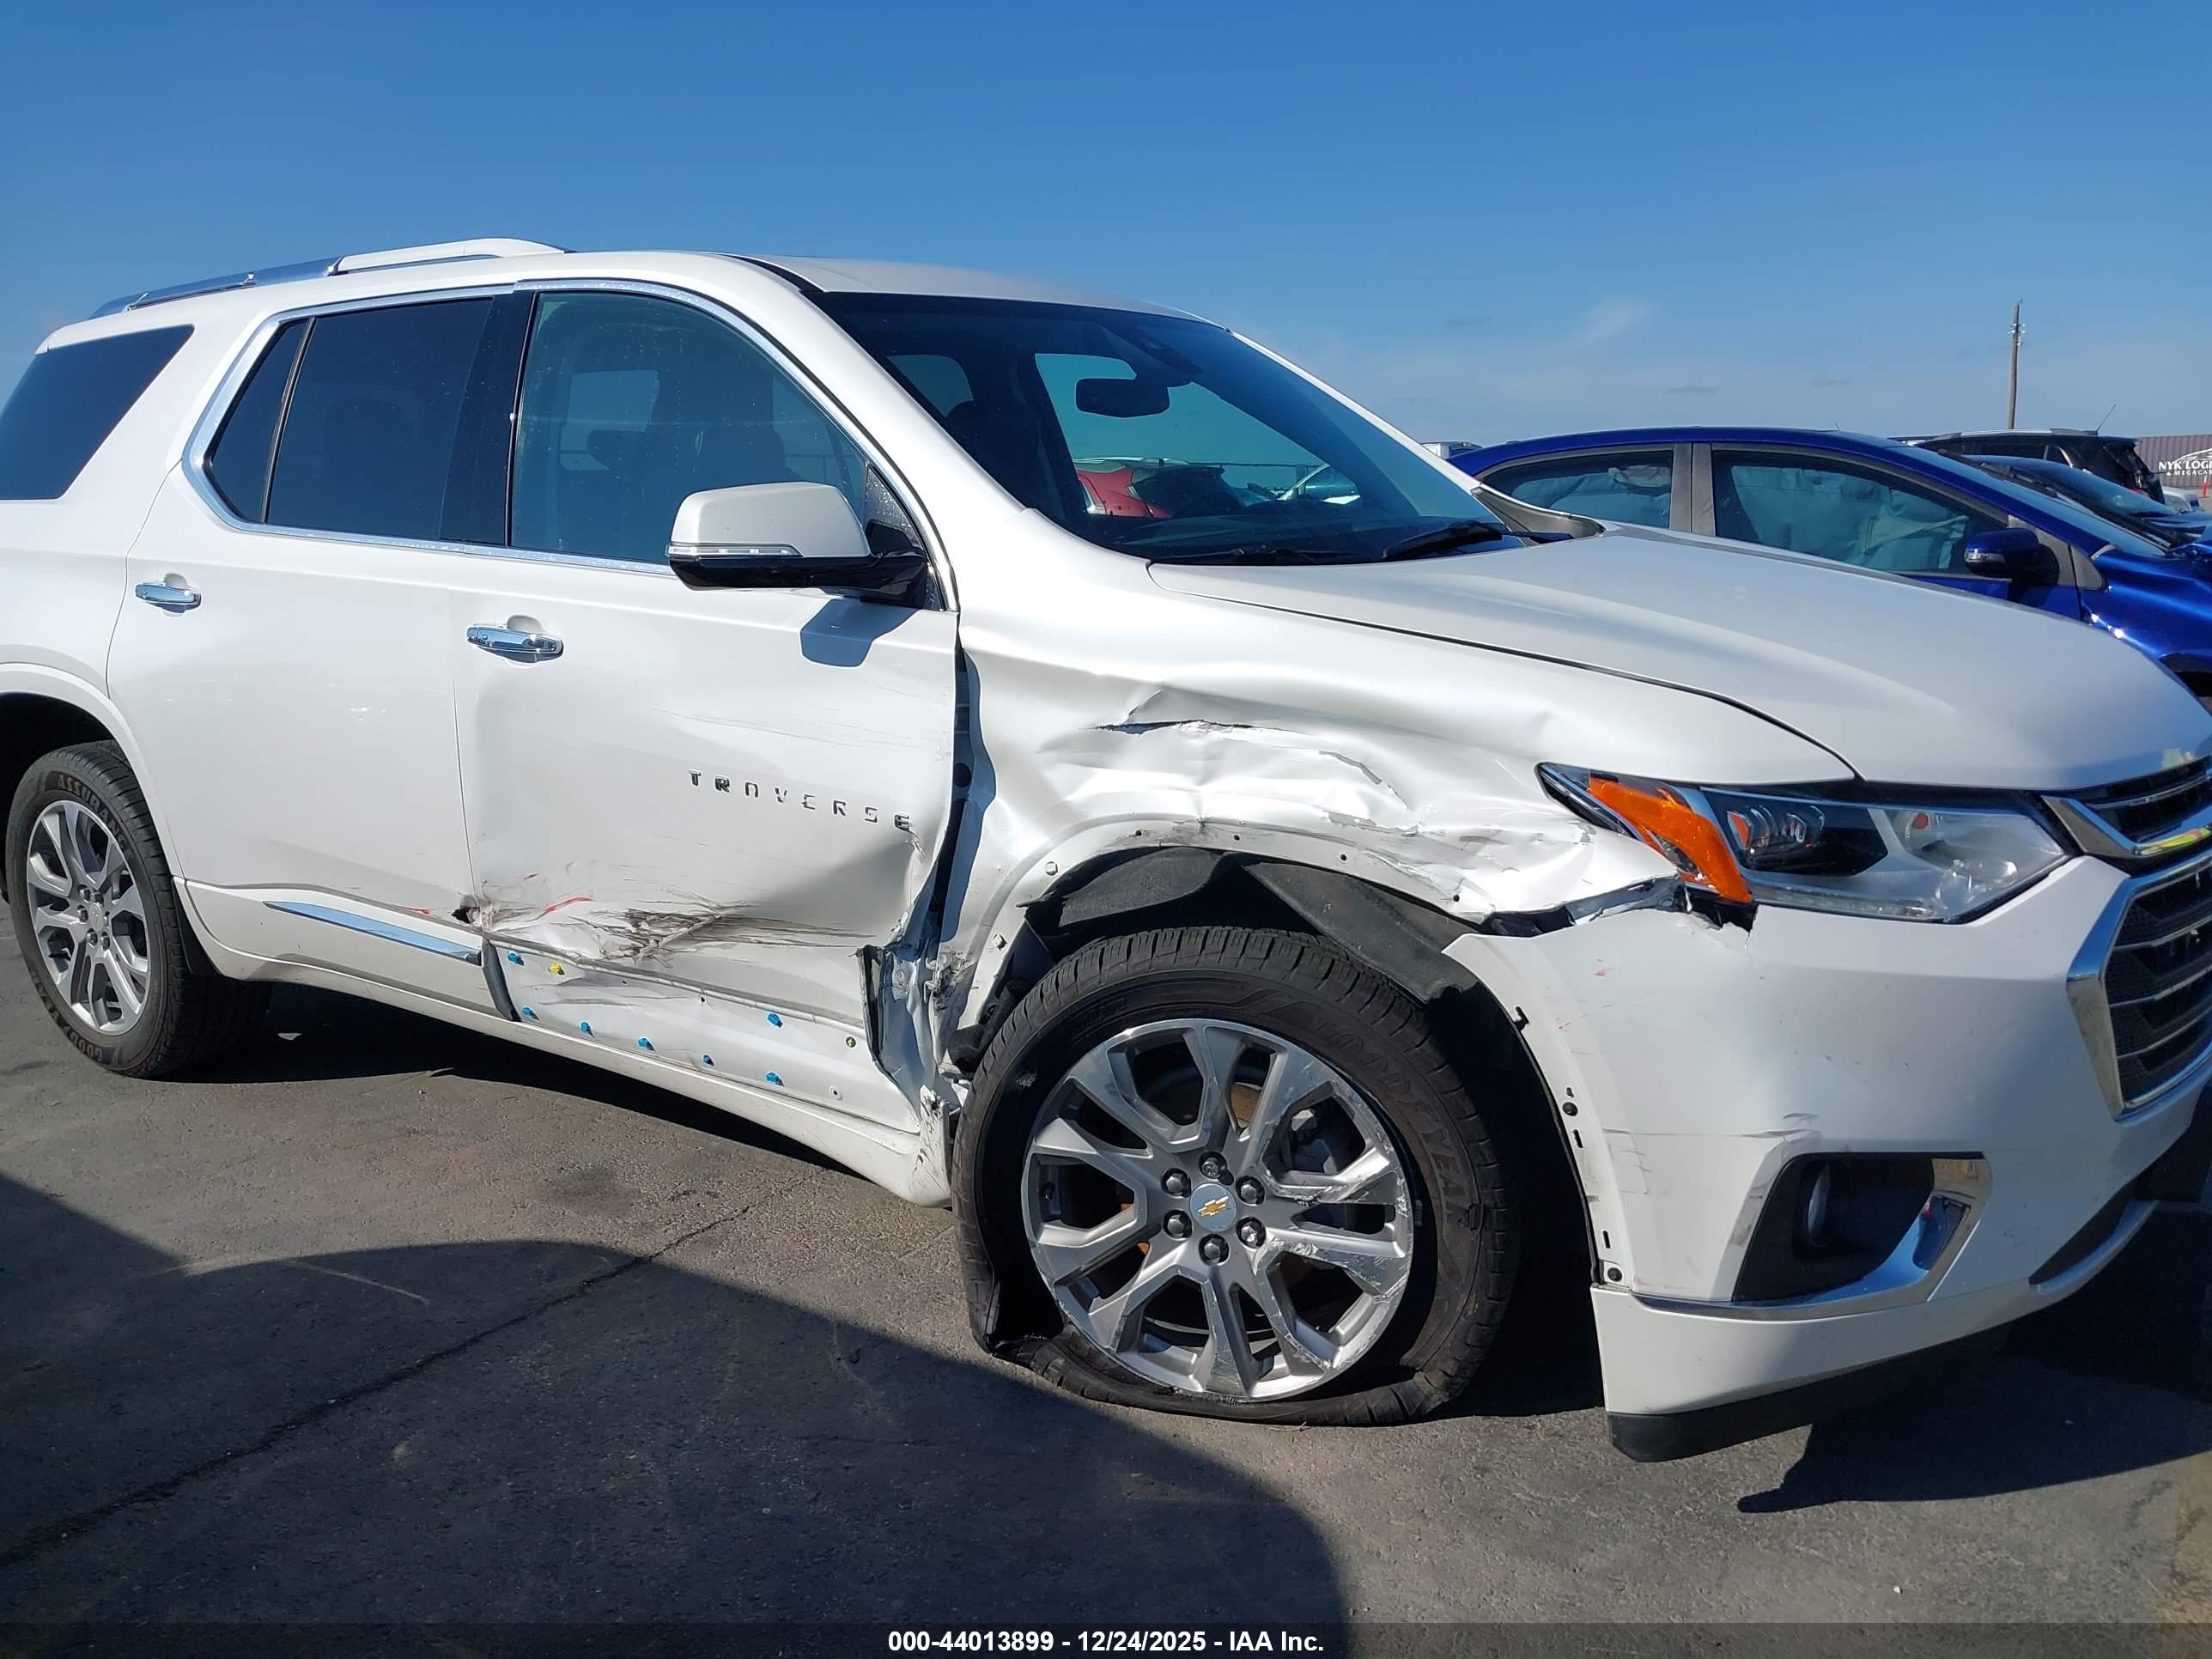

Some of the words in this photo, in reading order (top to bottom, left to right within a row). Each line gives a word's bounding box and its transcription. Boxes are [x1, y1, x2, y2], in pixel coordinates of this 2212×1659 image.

[2159, 461, 2182, 471] NYK
[58, 774, 136, 859] ASSURANCE
[688, 769, 915, 833] TRAVERSE
